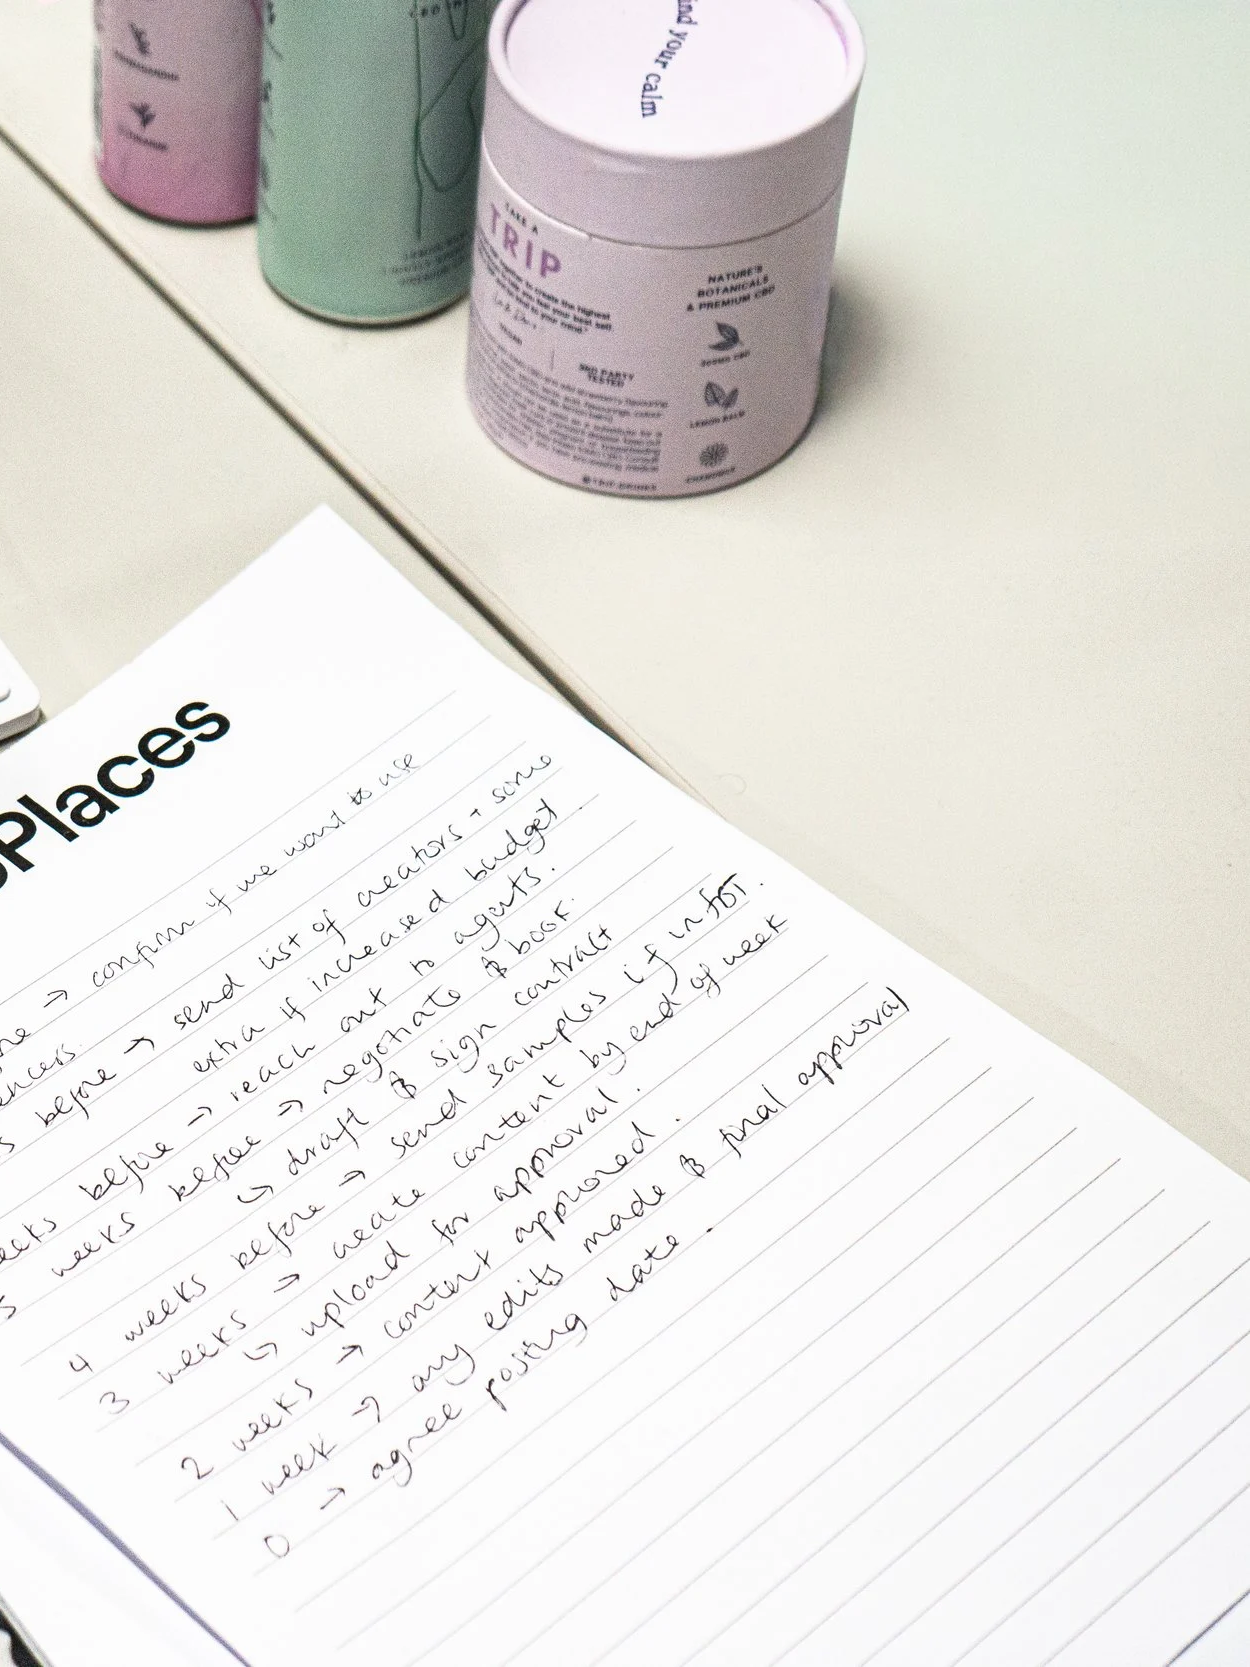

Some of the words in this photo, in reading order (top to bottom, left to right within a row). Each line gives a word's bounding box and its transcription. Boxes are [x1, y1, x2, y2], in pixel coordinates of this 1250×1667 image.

[641, 73, 664, 118] calm
[654, 29, 689, 69] your
[491, 202, 562, 278] TRIP
[697, 274, 769, 298] BOTANICALS
[699, 293, 751, 311] PREMIUM
[587, 374, 625, 388] TESTED
[600, 368, 634, 381] PARTY
[238, 866, 277, 892] we
[284, 810, 345, 856] want
[379, 754, 421, 787] use
[35, 1069, 117, 1128] before
[174, 973, 245, 1030] send
[259, 933, 300, 969] list
[313, 909, 346, 945] of
[358, 825, 462, 907] creators
[492, 756, 551, 804] some
[193, 1026, 265, 1072] extra
[308, 889, 450, 993] increased
[52, 1212, 135, 1277] weeks
[168, 1136, 261, 1202] before
[323, 987, 461, 1094] negotiate
[78, 1142, 172, 1201] before
[231, 1045, 315, 1101] reach
[341, 988, 387, 1033] out
[287, 1108, 369, 1175] draft
[431, 1024, 496, 1073] sign
[515, 925, 612, 1006] contract
[68, 1353, 93, 1374] 4
[125, 1274, 206, 1341] weeks
[232, 1205, 325, 1270] before
[391, 1089, 467, 1159] send
[487, 992, 606, 1088] samples
[99, 1391, 130, 1414] 3
[158, 1311, 246, 1384] weeks
[333, 1189, 425, 1259] create
[453, 1074, 565, 1168] content
[579, 1042, 626, 1074] by
[630, 993, 681, 1042] end
[690, 963, 721, 998] of
[723, 915, 787, 965] week
[262, 1433, 337, 1495] week
[412, 1344, 475, 1392] any
[484, 1264, 563, 1331] edits
[584, 1185, 666, 1253] made
[719, 1084, 787, 1158] final
[798, 987, 909, 1085] approval
[301, 1240, 410, 1336] upload
[431, 1213, 469, 1246] for
[181, 1457, 213, 1480] 2
[232, 1379, 313, 1451] weeks
[384, 1250, 491, 1338] content
[372, 1402, 462, 1487] agree
[486, 1314, 587, 1409] posting
